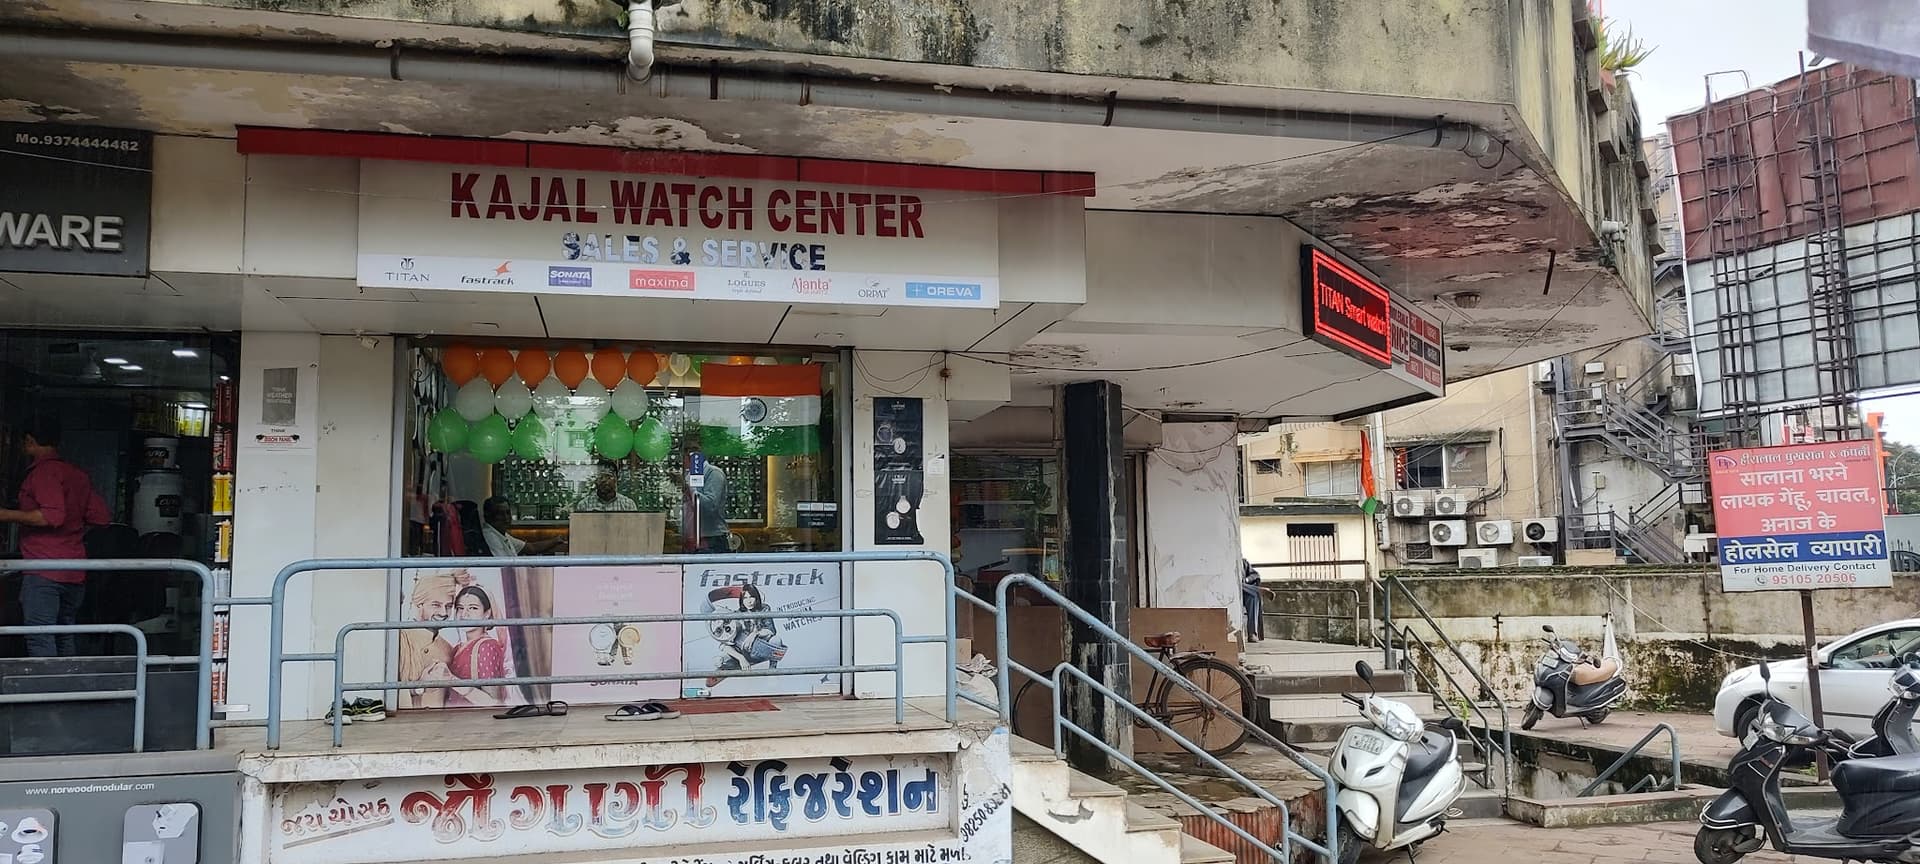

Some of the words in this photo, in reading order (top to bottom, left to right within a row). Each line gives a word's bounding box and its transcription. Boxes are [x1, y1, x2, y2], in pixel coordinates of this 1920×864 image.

[451, 172, 598, 223] KAJAL
[611, 180, 753, 230] WATCH
[767, 189, 924, 239] CENTER
[562, 231, 659, 264] SALES
[670, 236, 692, 265] &
[701, 237, 826, 270] SERVICE
[385, 271, 431, 282] TITAN
[461, 275, 515, 286] fastrack
[550, 270, 591, 280] SONATA
[635, 277, 688, 288] maxima
[792, 277, 830, 293] Ajanta
[926, 286, 973, 297] OREVA
[1319, 282, 1344, 315] TITAN
[1344, 296, 1366, 327] Smart
[1739, 468, 1804, 487] सालाना
[1808, 463, 1848, 482] भरने
[1720, 492, 1775, 510] लायक
[1816, 487, 1876, 504] चावल,
[1760, 515, 1813, 533] अनाज
[1817, 510, 1837, 530] के
[1723, 538, 1799, 563] होलसेल
[1809, 533, 1882, 557] व्यापारी
[1734, 566, 1752, 574] For
[1754, 565, 1784, 574] Home
[1787, 563, 1830, 574] Delivery
[1833, 562, 1877, 571] Contact
[700, 568, 824, 587] fastrack
[1772, 574, 1812, 585] 95105
[1817, 573, 1857, 584] 20506
[24, 782, 155, 796] www.norwoodmodular.com
[886, 849, 910, 864] કામ
[914, 844, 937, 864] માટે
